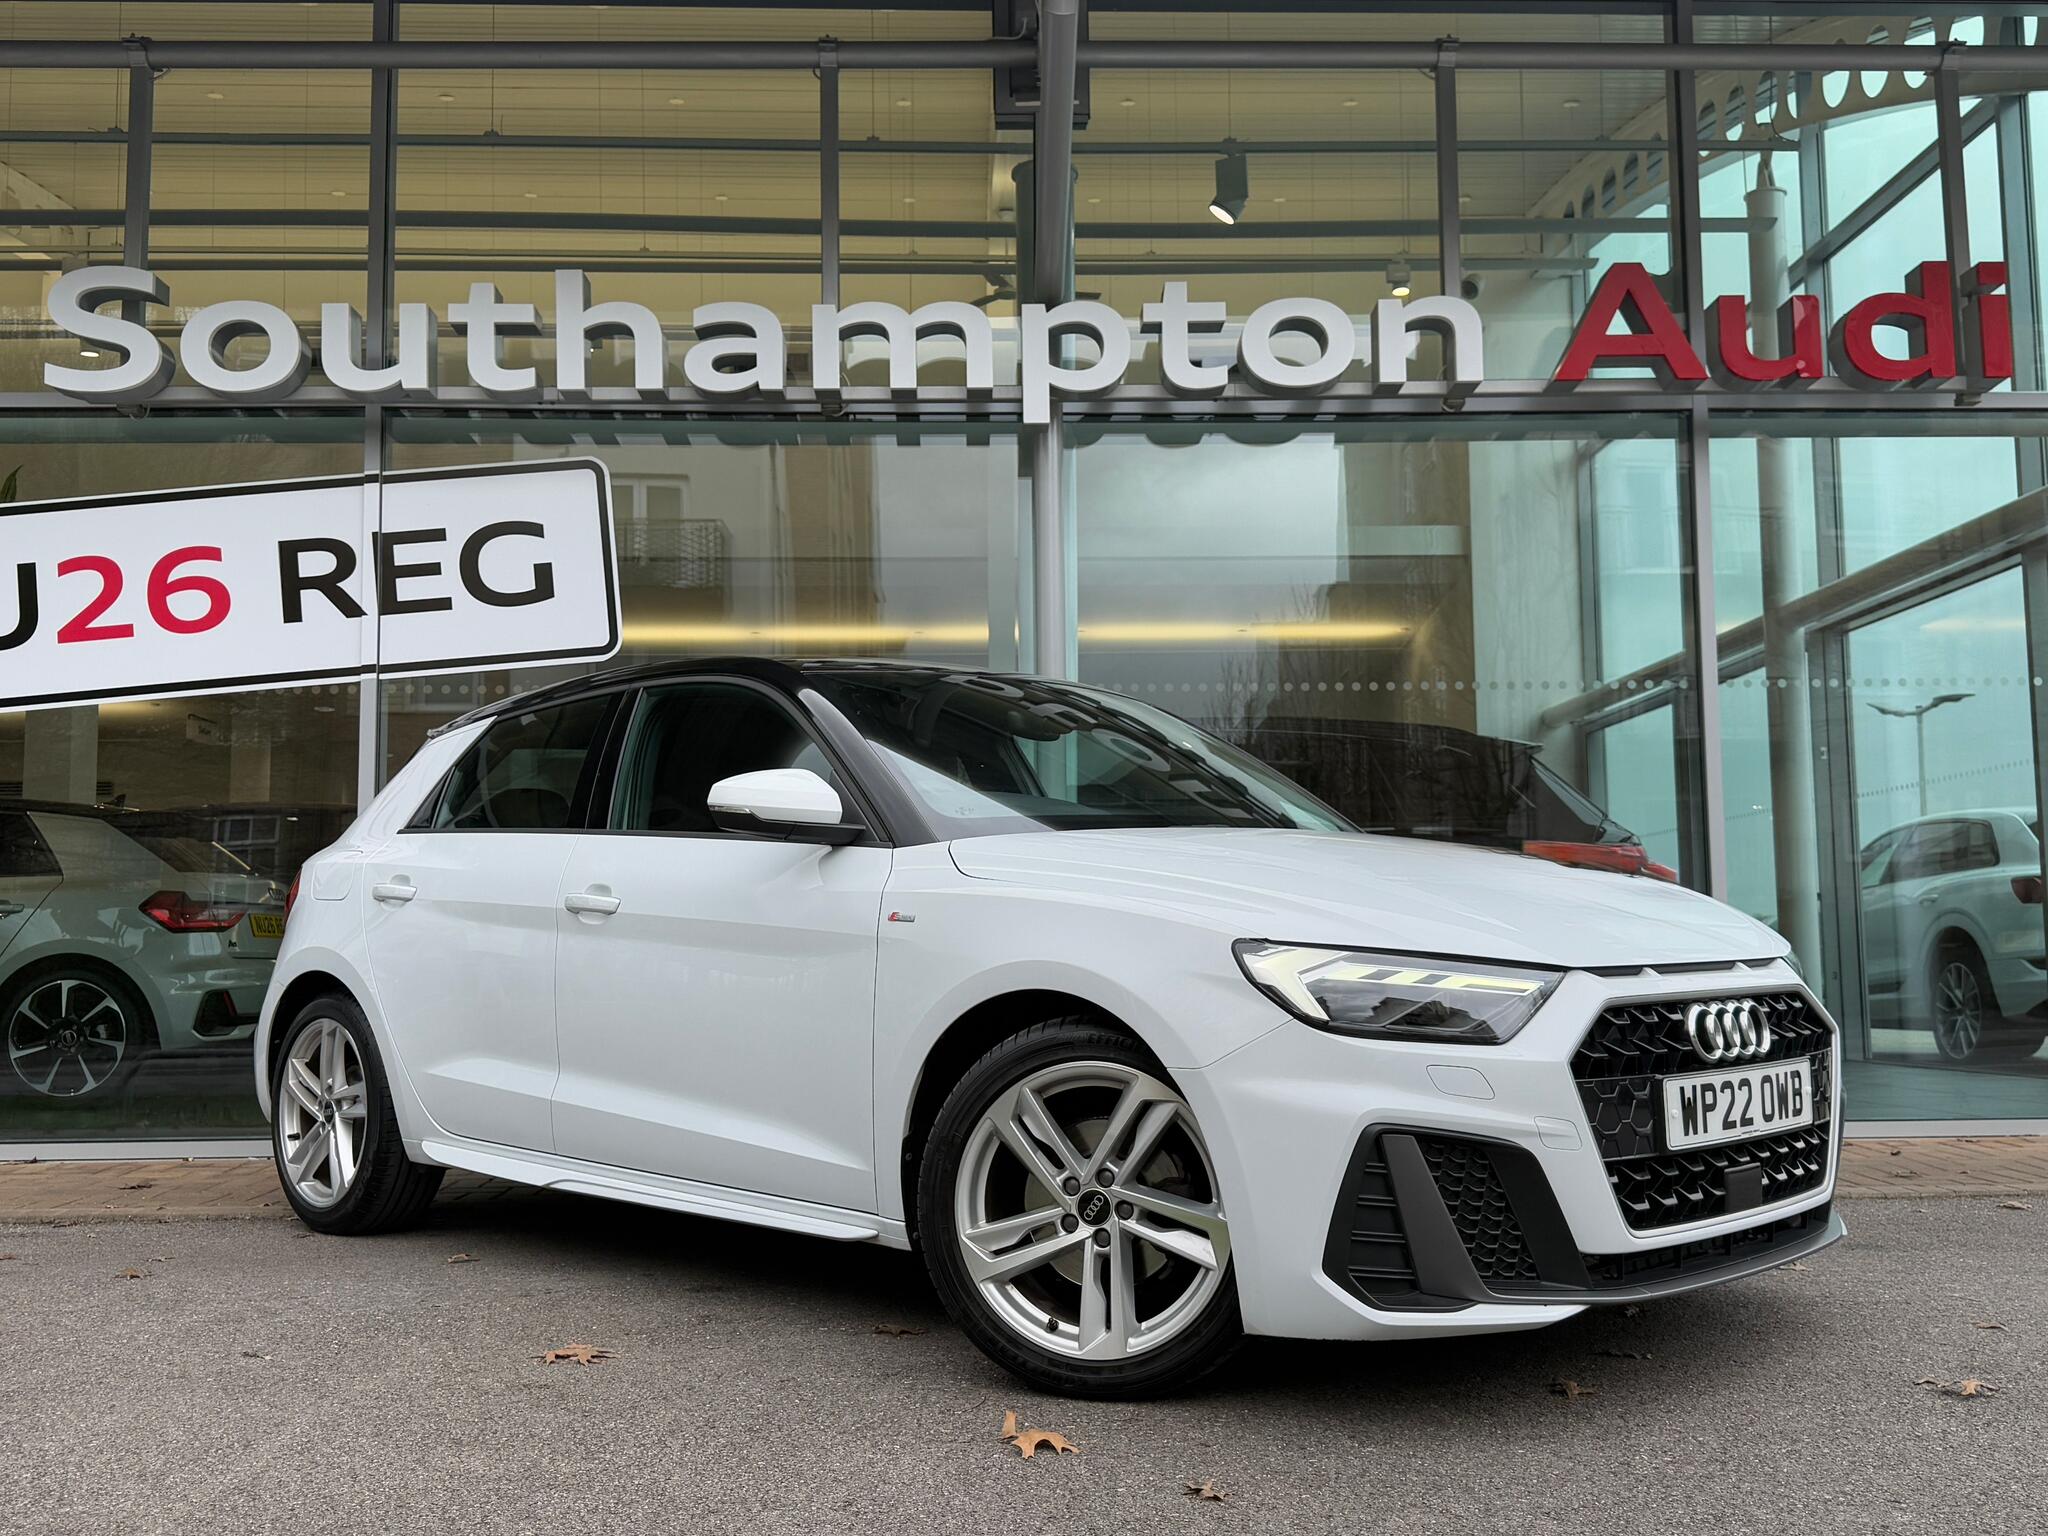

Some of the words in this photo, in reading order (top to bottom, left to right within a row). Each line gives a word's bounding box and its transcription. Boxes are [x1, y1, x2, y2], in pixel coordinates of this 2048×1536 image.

[43, 265, 1484, 424] Southampton
[1552, 261, 2014, 381] Audi
[278, 520, 555, 624] REG
[1680, 1078, 1754, 1137] WP22
[1760, 1070, 1803, 1123] OWB
